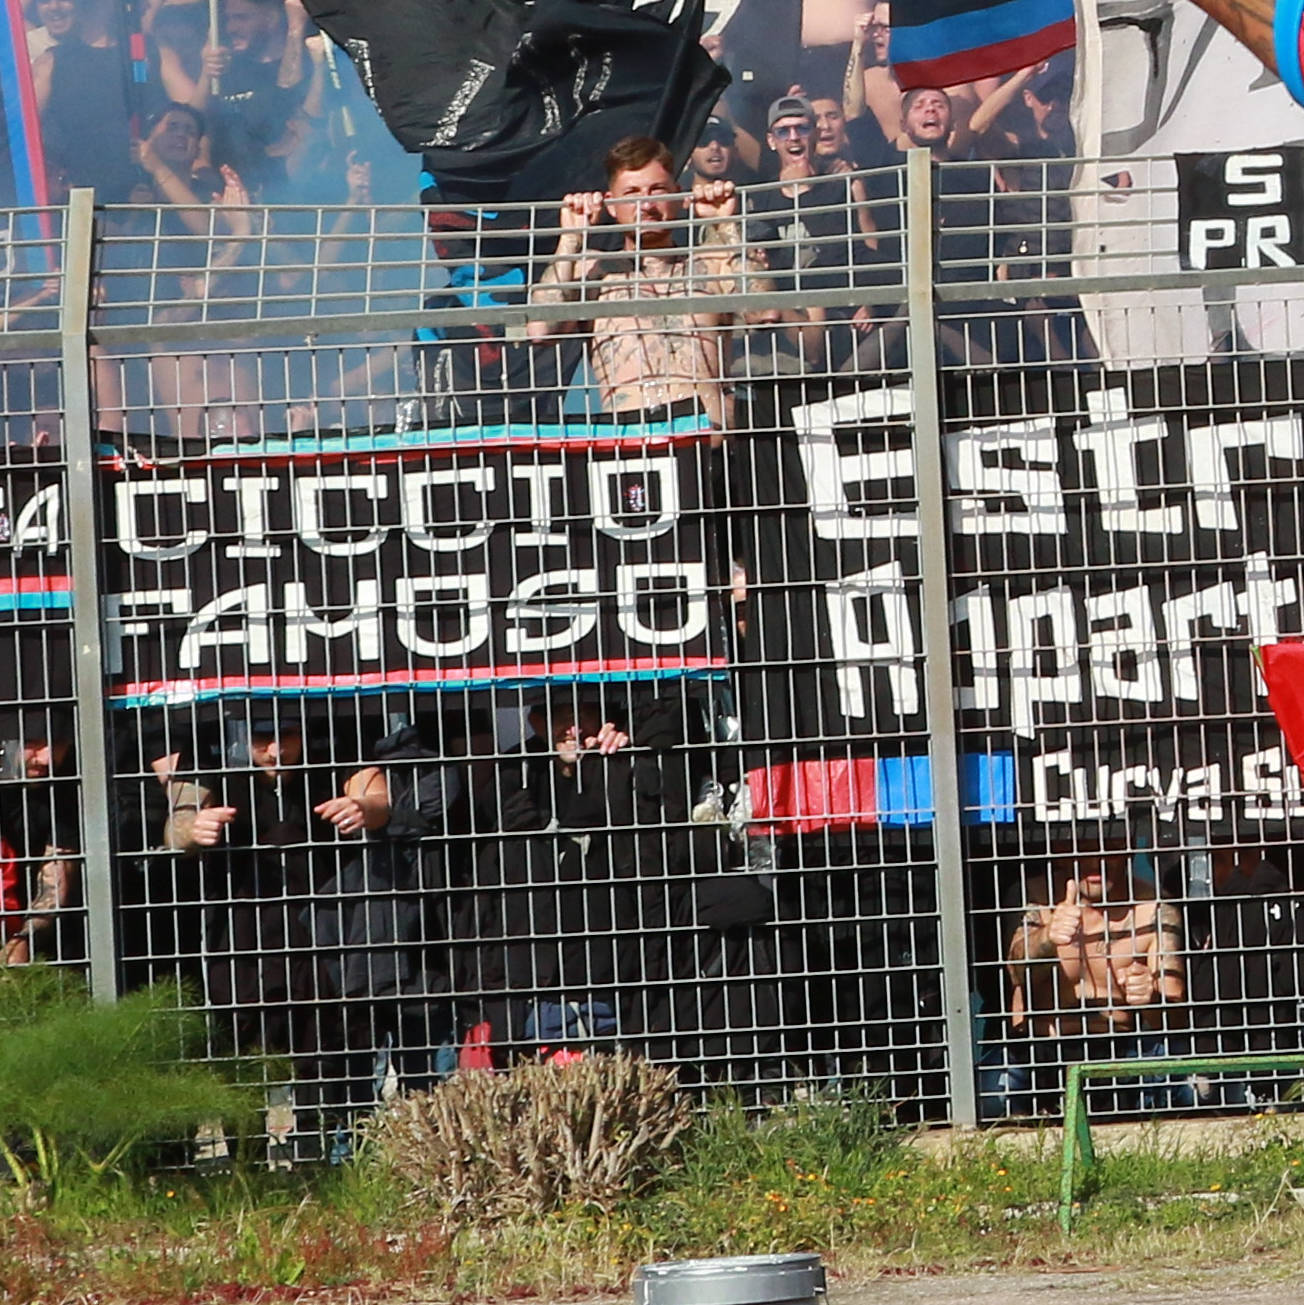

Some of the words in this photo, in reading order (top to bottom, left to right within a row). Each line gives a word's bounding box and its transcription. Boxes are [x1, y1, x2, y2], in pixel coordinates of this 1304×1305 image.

[114, 456, 681, 562] CICCIO
[102, 562, 709, 676] FAMOSO
[1032, 748, 1222, 823] Curva
